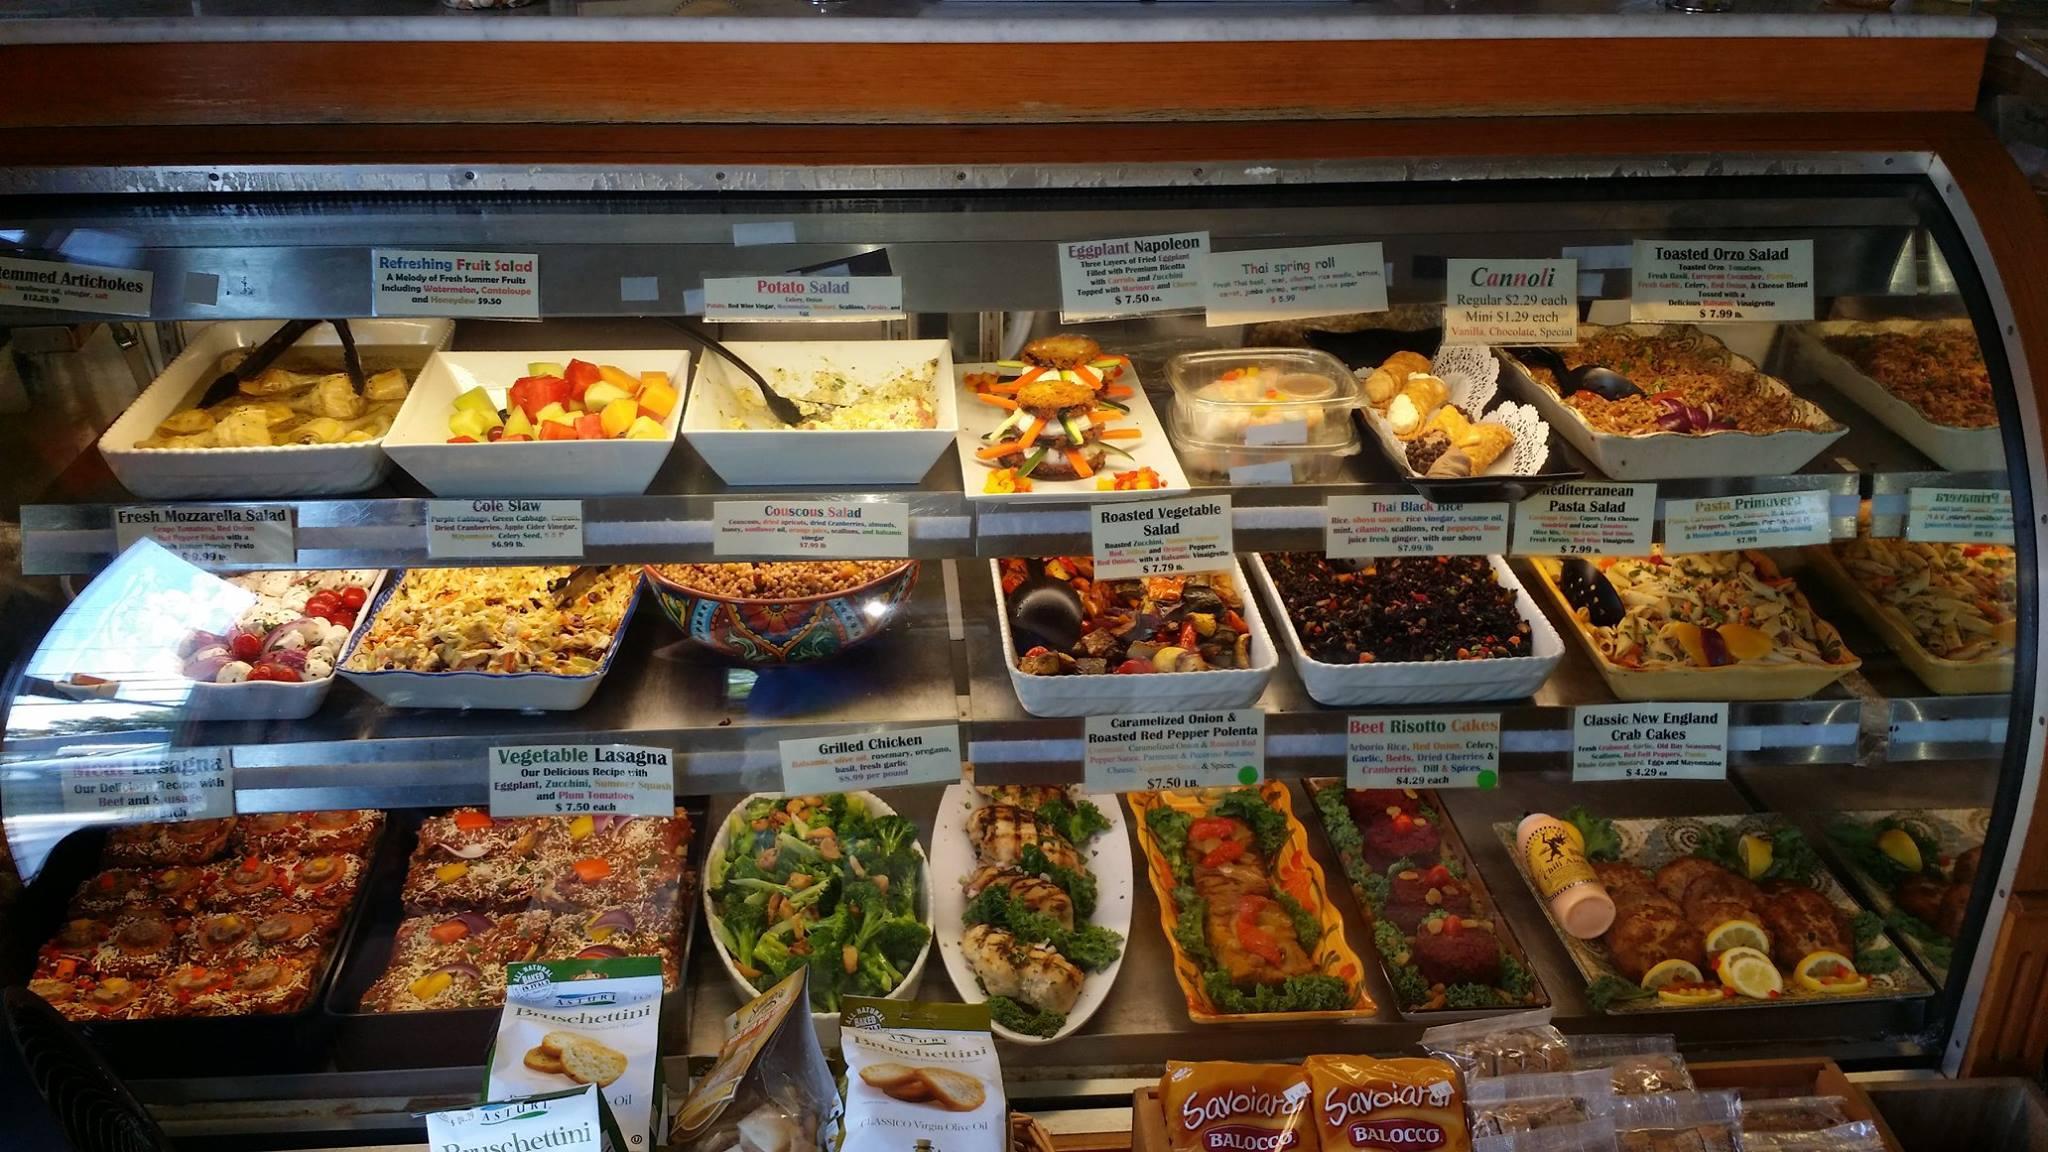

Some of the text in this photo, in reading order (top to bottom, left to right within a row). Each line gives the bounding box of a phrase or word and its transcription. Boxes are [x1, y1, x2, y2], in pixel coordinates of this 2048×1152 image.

[1069, 237, 1200, 259] Eggplant Napoleon
[1655, 247, 1788, 261] Toasted Orzo Salad
[380, 257, 532, 272] Refreshing Fruit Salad
[1103, 258, 1126, 267] Layers
[1125, 265, 1157, 274] Premium
[1160, 263, 1185, 271] Ricotta
[1242, 257, 1335, 275] Thai spring roll
[0, 266, 56, 283] temmed
[61, 272, 143, 292] Artichokes
[1471, 267, 1555, 287] Cannoli
[382, 284, 479, 294] Including Watermelon,
[757, 281, 849, 293] Potato Salad
[1115, 294, 1149, 305] $ 7.50
[1457, 294, 1568, 308] Regular $2.29 each
[1466, 312, 1558, 323] Mini $1.29 each
[1700, 310, 1732, 318] $ 7.99
[1489, 327, 1572, 338] Chocolate, Special
[1541, 485, 1634, 496] editerranean
[473, 500, 541, 512] Cole Slaw
[1372, 502, 1397, 512] Thai
[1400, 501, 1433, 512] Black
[1550, 501, 1625, 512] Pasta Salad
[1695, 496, 1801, 512] Pasta Primavera
[119, 510, 286, 523] Fresh Mozzarella Salad
[765, 505, 861, 518] Couscous Salad
[1101, 504, 1221, 523] Roasted Vegetable
[1144, 523, 1180, 536] Salad
[1152, 564, 1174, 572] 7.79
[1111, 712, 1236, 728] Caramelized Onion &
[1583, 713, 1718, 726] Classic New England
[1350, 718, 1498, 734] Beet Risotto Cakes
[1089, 726, 1258, 743] Roasted Red Pepper Polenta
[1611, 729, 1686, 741] Crab Cakes
[819, 736, 922, 754] Grilled Chicken
[1466, 741, 1498, 749] Celery,
[498, 748, 667, 766] Vegetable Lasagna
[872, 751, 912, 760] rosemary,
[1352, 755, 1383, 763] Garlic,
[1417, 753, 1442, 761] Dried
[1446, 752, 1484, 761] Cherries
[860, 762, 881, 770] fresh
[884, 761, 907, 770] garlic
[544, 768, 589, 776] Delicious
[592, 768, 625, 777] Recipe
[1635, 768, 1656, 776] 4.29
[494, 780, 591, 791] Eggplant, Zucchini,
[1147, 777, 1199, 789] $7.50 LB.
[1396, 776, 1449, 785] $4.29 each
[128, 796, 149, 805] and
[559, 791, 584, 799] Plum
[588, 791, 634, 799] Tomatoes
[555, 804, 562, 812] $
[566, 803, 590, 811] 7.50
[523, 971, 545, 984] BAKED
[516, 1005, 650, 1024] Bruschettini
[614, 1095, 632, 1105] Oil
[482, 1102, 549, 1121] ASTURI
[1183, 1086, 1298, 1130] Savoiar
[914, 1120, 943, 1131] Virgin
[973, 1121, 987, 1130] Oil
[1209, 1131, 1293, 1150] BALOCCO
[1353, 1127, 1440, 1142] BALOCCO
